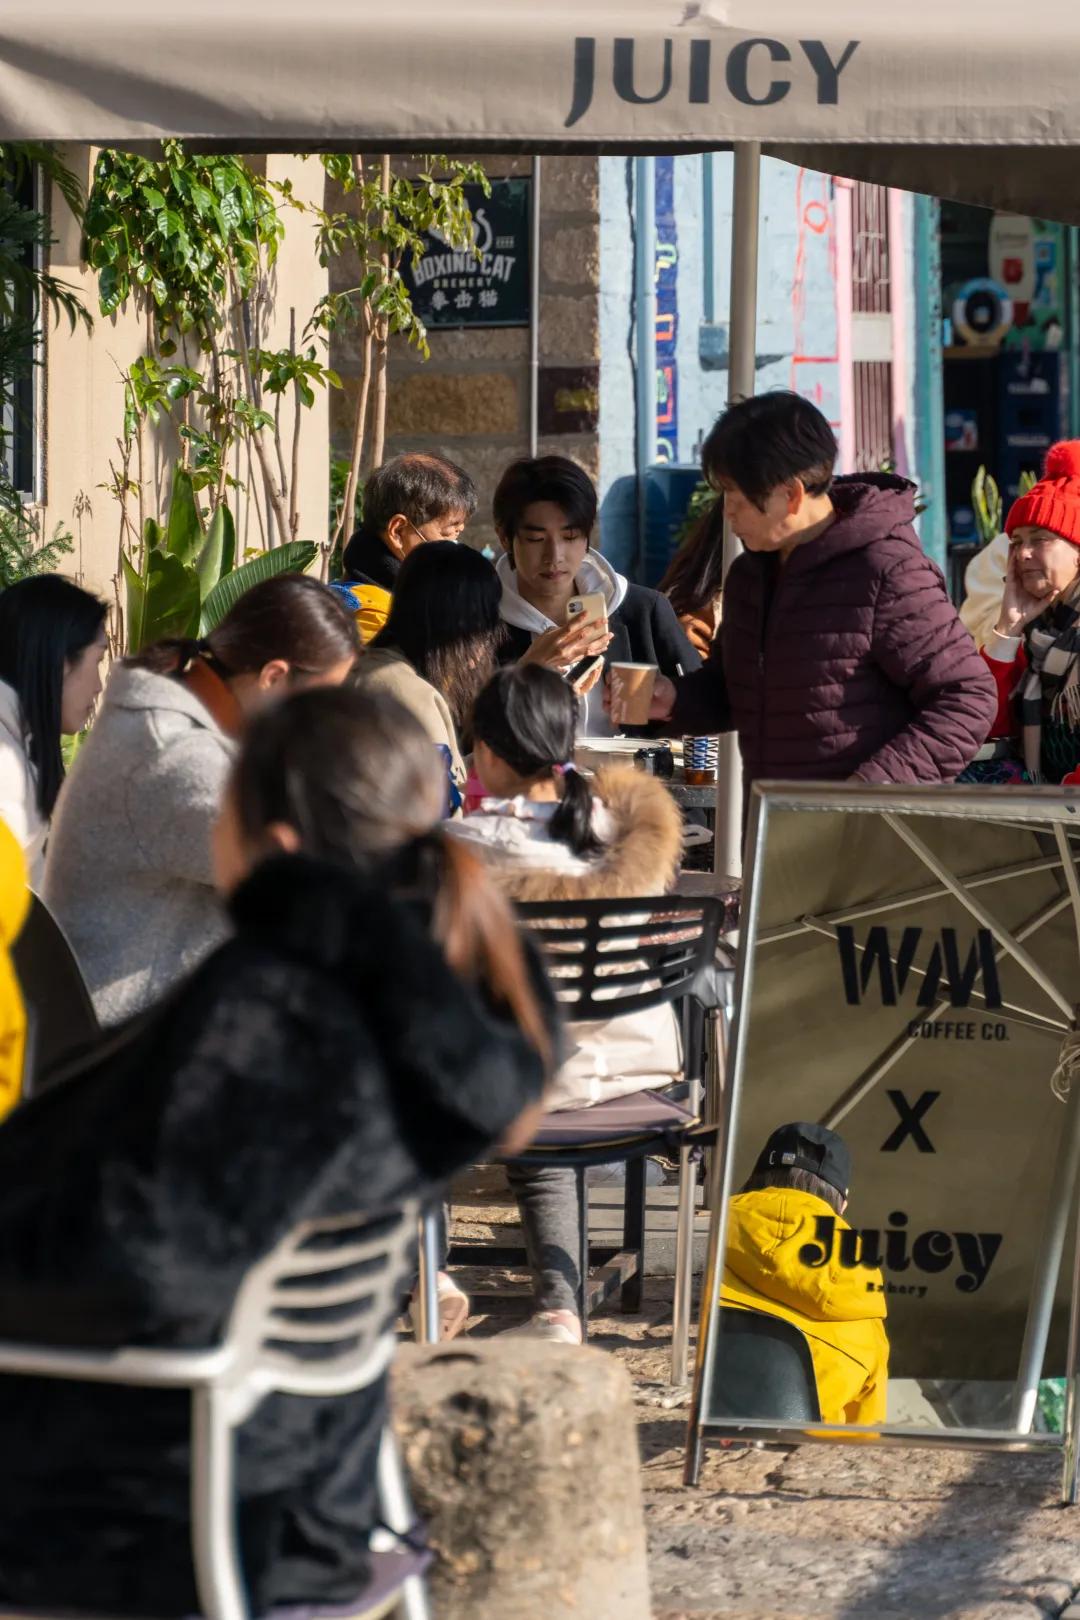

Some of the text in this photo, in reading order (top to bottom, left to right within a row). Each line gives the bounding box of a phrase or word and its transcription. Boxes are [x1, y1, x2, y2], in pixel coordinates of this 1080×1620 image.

[564, 37, 861, 128] JUICY
[411, 253, 516, 286] BOXING CAT
[836, 925, 1002, 1009] WM
[908, 1020, 1010, 1041] COFFEE CO.
[880, 1089, 940, 1153] X
[798, 1211, 1003, 1293] Juicy
